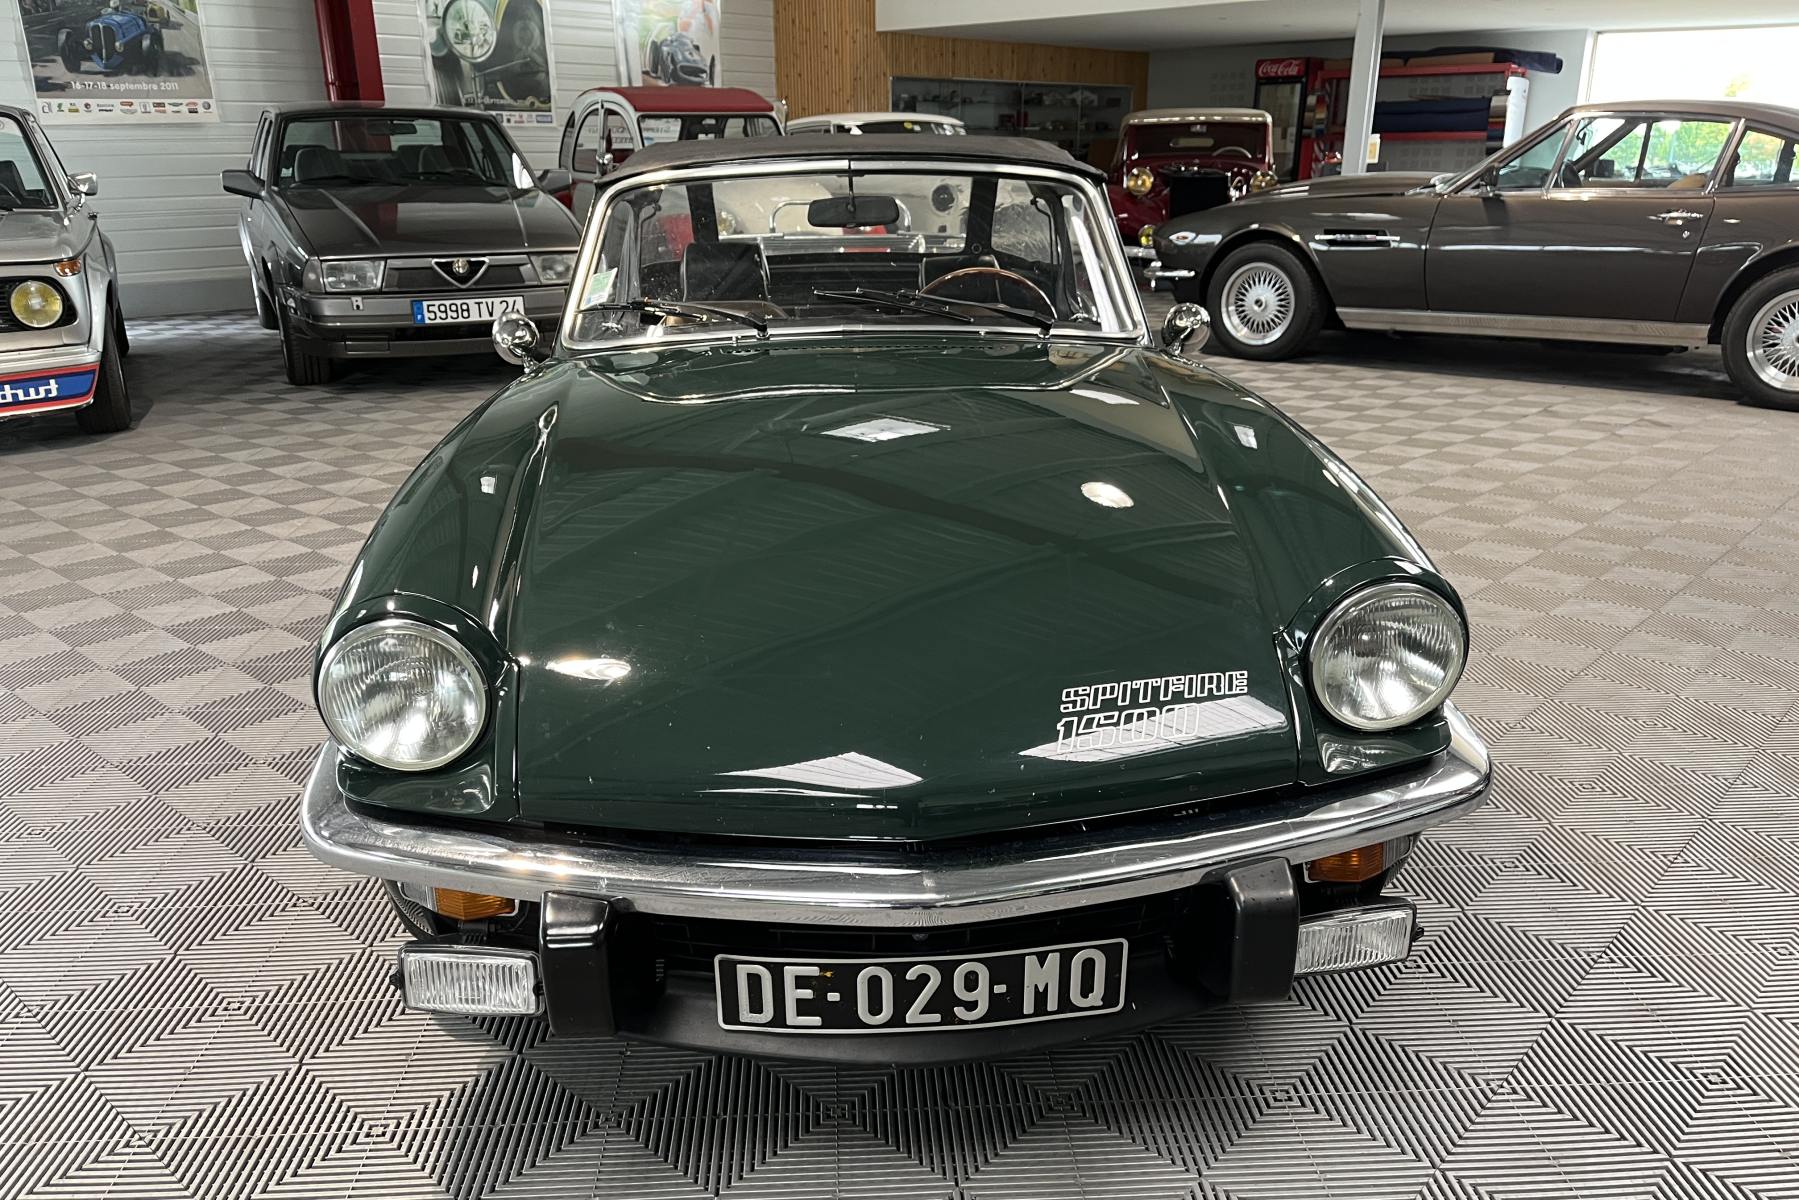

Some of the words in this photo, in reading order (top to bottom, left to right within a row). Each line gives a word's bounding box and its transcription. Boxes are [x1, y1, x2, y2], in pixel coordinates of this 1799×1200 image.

[70, 81, 107, 90] 16-17-18
[110, 81, 158, 92] septembre
[160, 82, 179, 91] 2011
[426, 302, 470, 321] 5998
[474, 301, 495, 318] TV
[1060, 670, 1248, 713] SPITFIRE
[1056, 702, 1200, 753] 1500
[736, 948, 1106, 1026] DE-029-MQ
